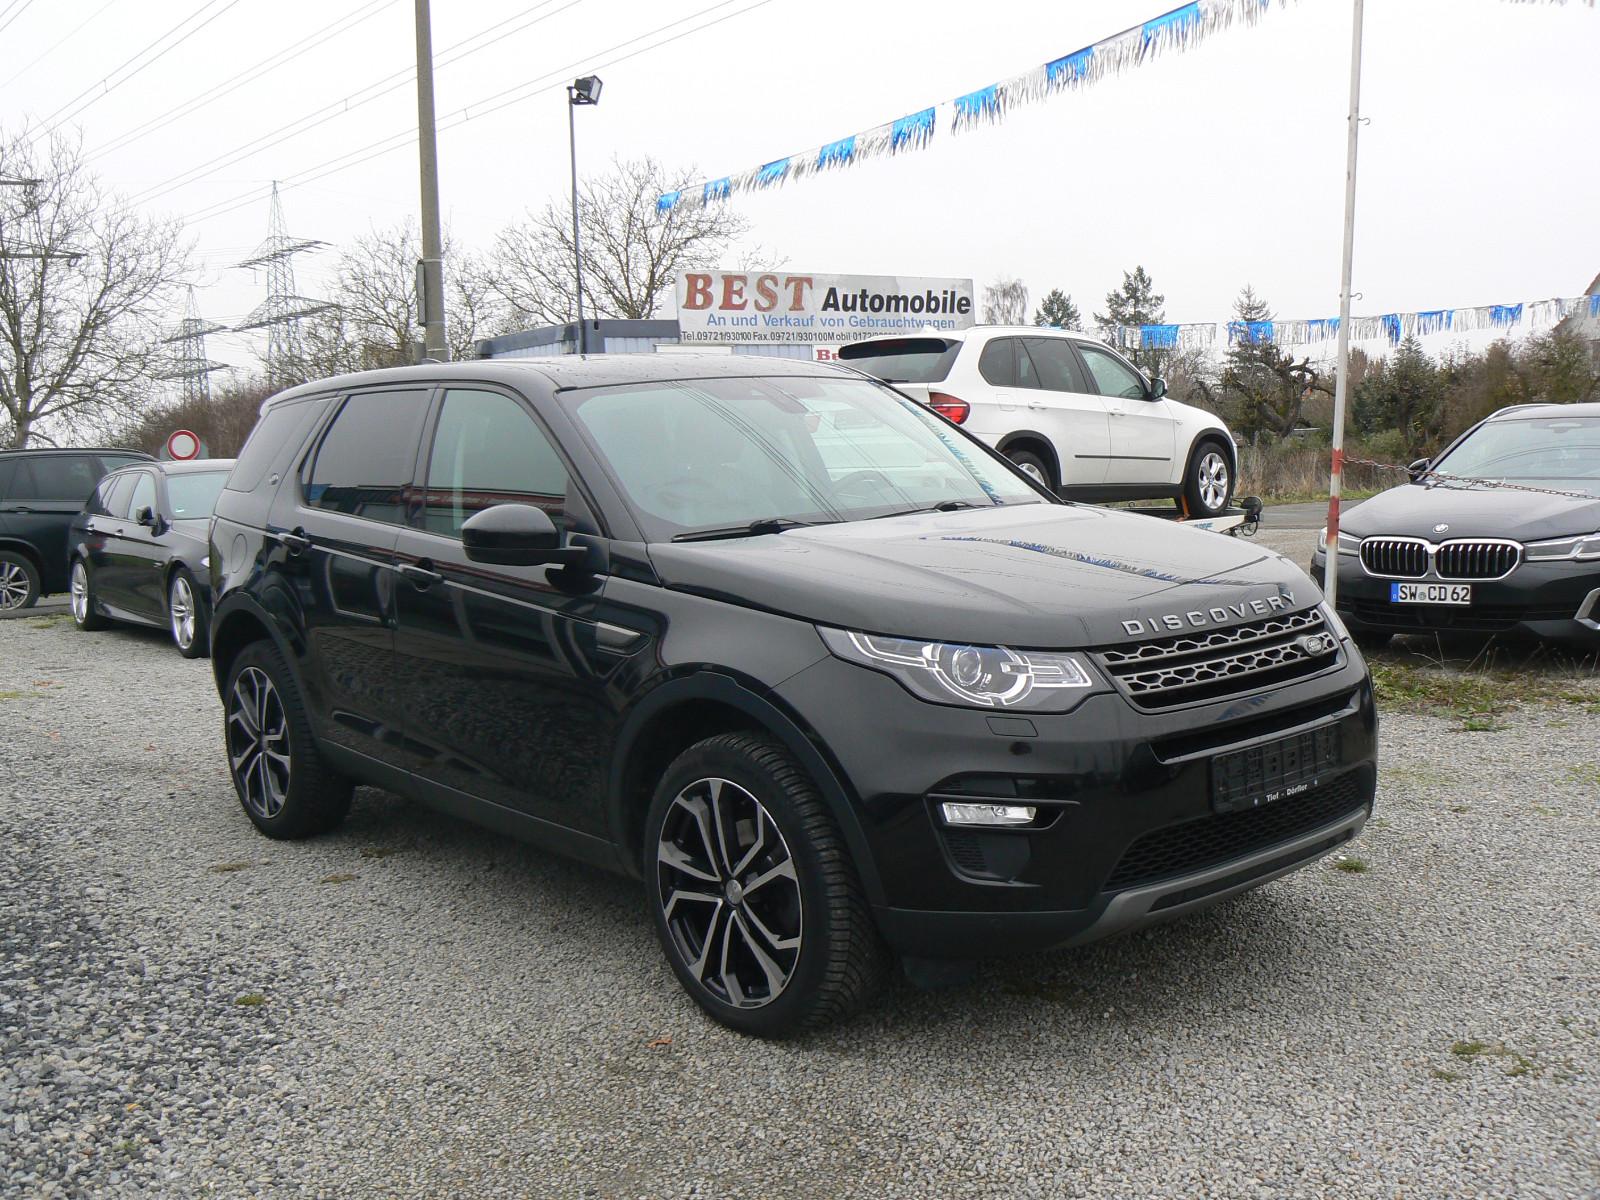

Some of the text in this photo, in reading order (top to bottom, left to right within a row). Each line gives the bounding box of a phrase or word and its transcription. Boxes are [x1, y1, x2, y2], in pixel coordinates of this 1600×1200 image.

[682, 273, 971, 314] BEST Automobile
[707, 313, 955, 330] An und Verkauf von Gebrauchtwagen
[1399, 585, 1471, 602] SW CD 62
[1121, 591, 1297, 636] DISCOVERY
